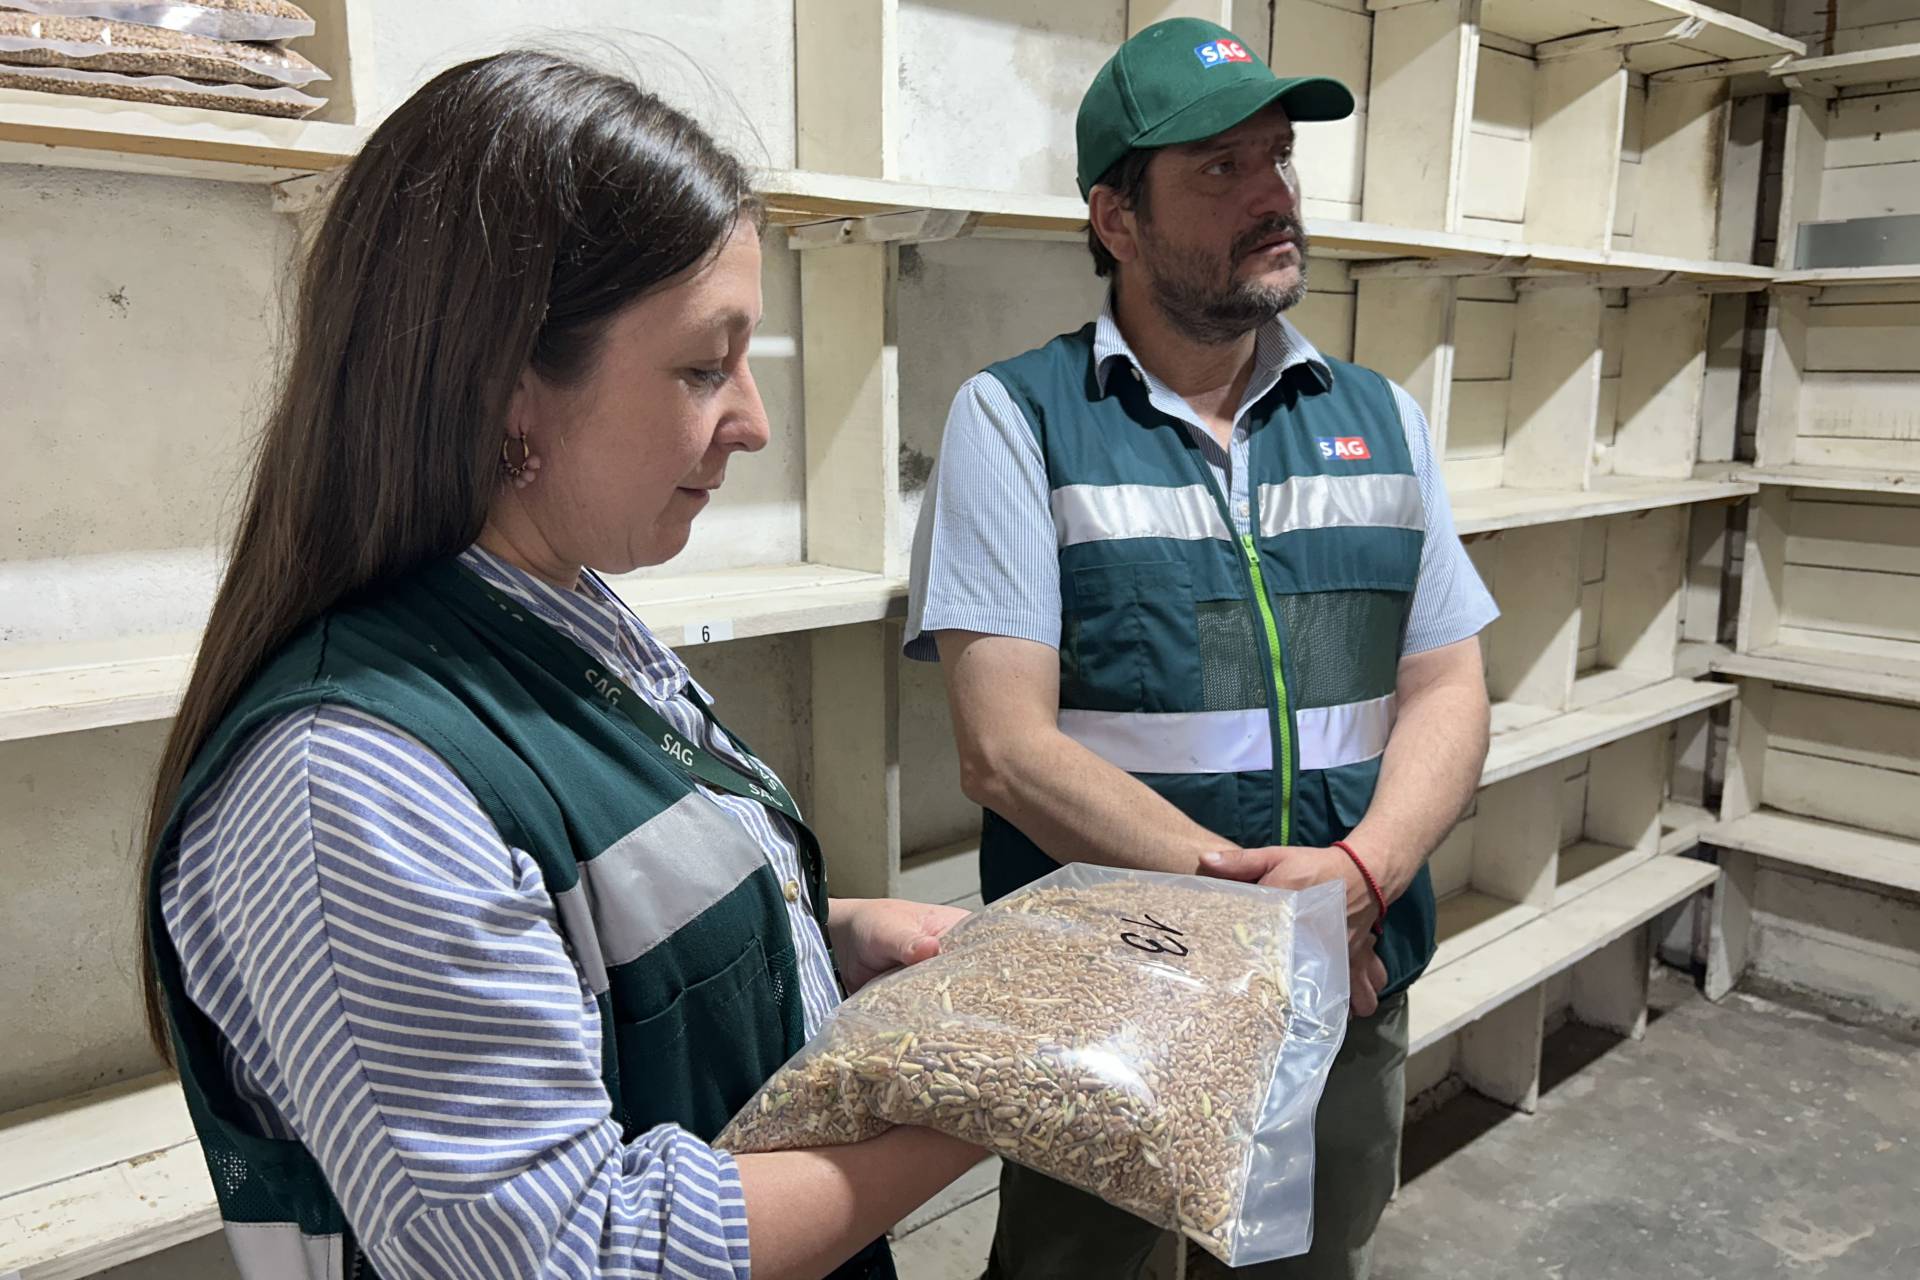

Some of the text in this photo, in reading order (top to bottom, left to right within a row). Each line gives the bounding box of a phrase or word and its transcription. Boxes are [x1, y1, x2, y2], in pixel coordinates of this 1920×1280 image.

[1201, 43, 1246, 62] SAG
[1319, 441, 1364, 456] SAG
[702, 625, 710, 643] 6
[660, 733, 694, 767] SAG
